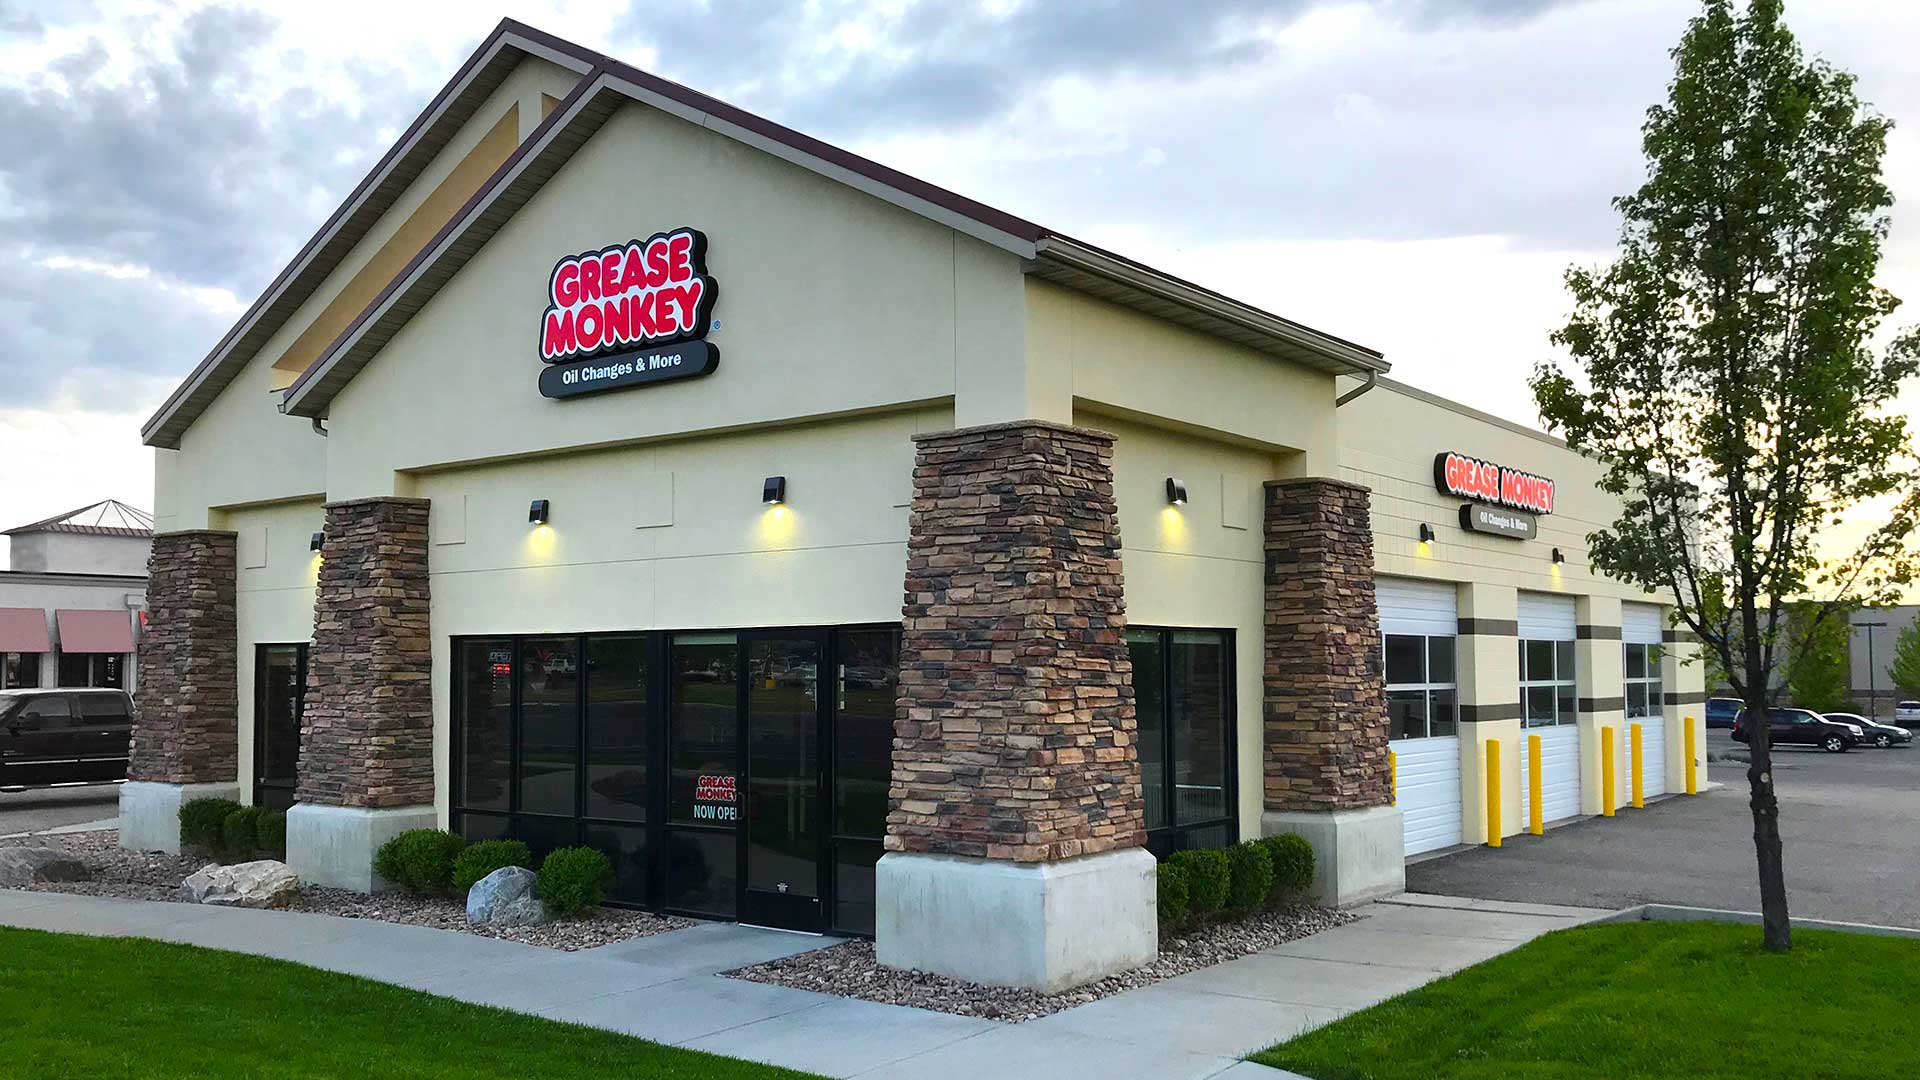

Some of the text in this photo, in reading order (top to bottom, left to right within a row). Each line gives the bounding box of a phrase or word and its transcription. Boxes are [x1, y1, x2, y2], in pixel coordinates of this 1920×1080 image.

[555, 236, 691, 308] GREASE
[544, 282, 701, 356] MONKEY
[562, 353, 681, 385] Oil Changes & More
[1446, 455, 1554, 511] GREASE MONKEY
[1488, 513, 1510, 528] Changes
[698, 775, 736, 788] GREASE
[696, 787, 737, 801] MONKEY
[693, 804, 716, 819] NOW
